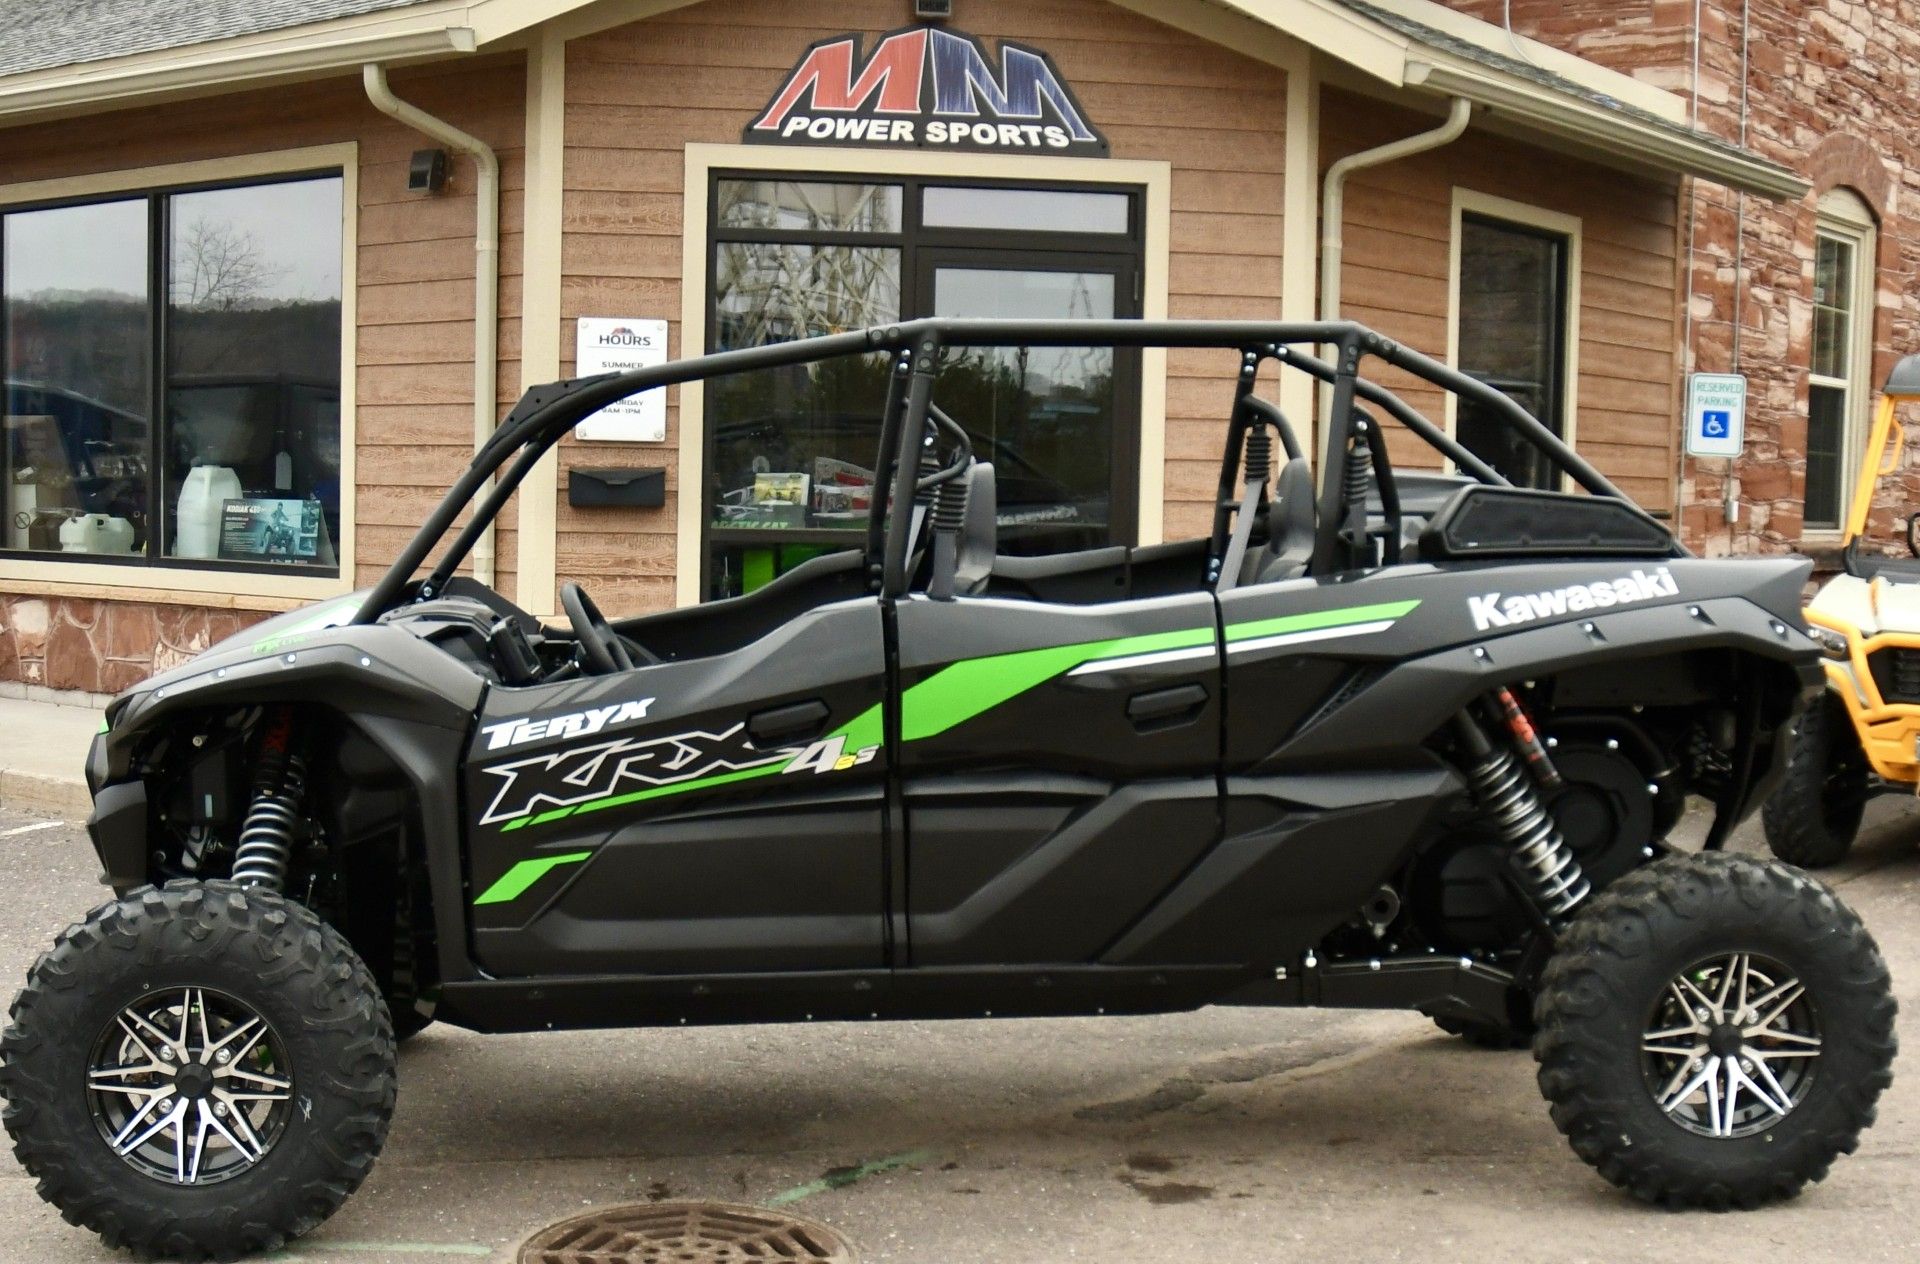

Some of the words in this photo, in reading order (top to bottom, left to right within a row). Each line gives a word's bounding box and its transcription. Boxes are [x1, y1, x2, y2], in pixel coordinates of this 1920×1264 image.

[782, 117, 915, 143] POWER
[925, 120, 1073, 148] SPORTS
[599, 335, 651, 346] HOURS
[1696, 382, 1743, 393] RESERVED
[1698, 395, 1738, 407] PARKING
[1467, 568, 1679, 631] Kawasaki
[482, 697, 656, 750] TERYX
[478, 721, 806, 826] KRX
